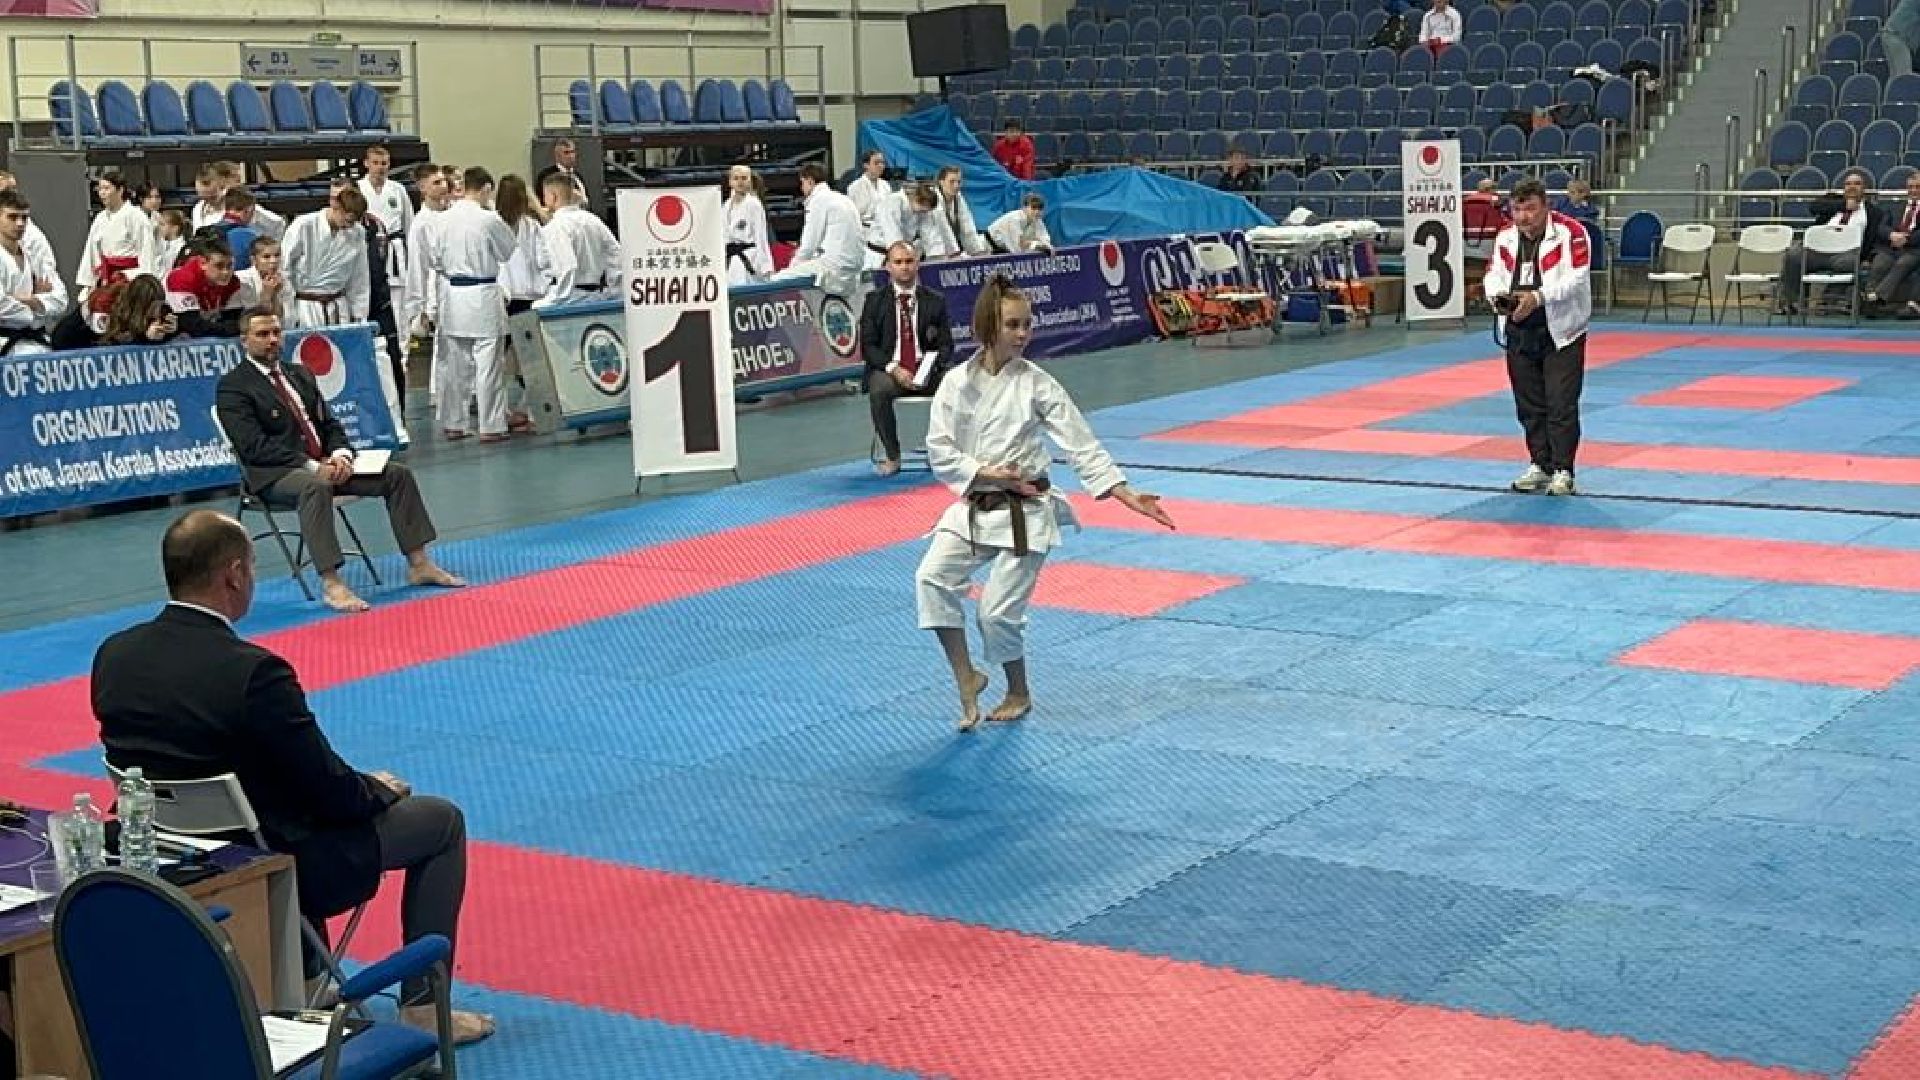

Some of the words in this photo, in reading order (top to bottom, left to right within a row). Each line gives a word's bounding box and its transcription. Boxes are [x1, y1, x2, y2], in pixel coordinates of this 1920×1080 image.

[971, 266, 981, 285] OF
[1413, 220, 1453, 310] 3
[631, 276, 688, 305] SHIAI
[693, 274, 719, 302] JO
[735, 299, 812, 331] СПОРТА
[3, 362, 30, 397] OF
[33, 350, 142, 394] SHOTO-KAN
[143, 344, 241, 382] KARATE-DO
[643, 309, 721, 454] 1
[33, 398, 180, 447] ORGANIZATIONS
[5, 464, 25, 494] of
[25, 462, 54, 490] the
[56, 457, 105, 491] Japan
[103, 449, 156, 480] Karate
